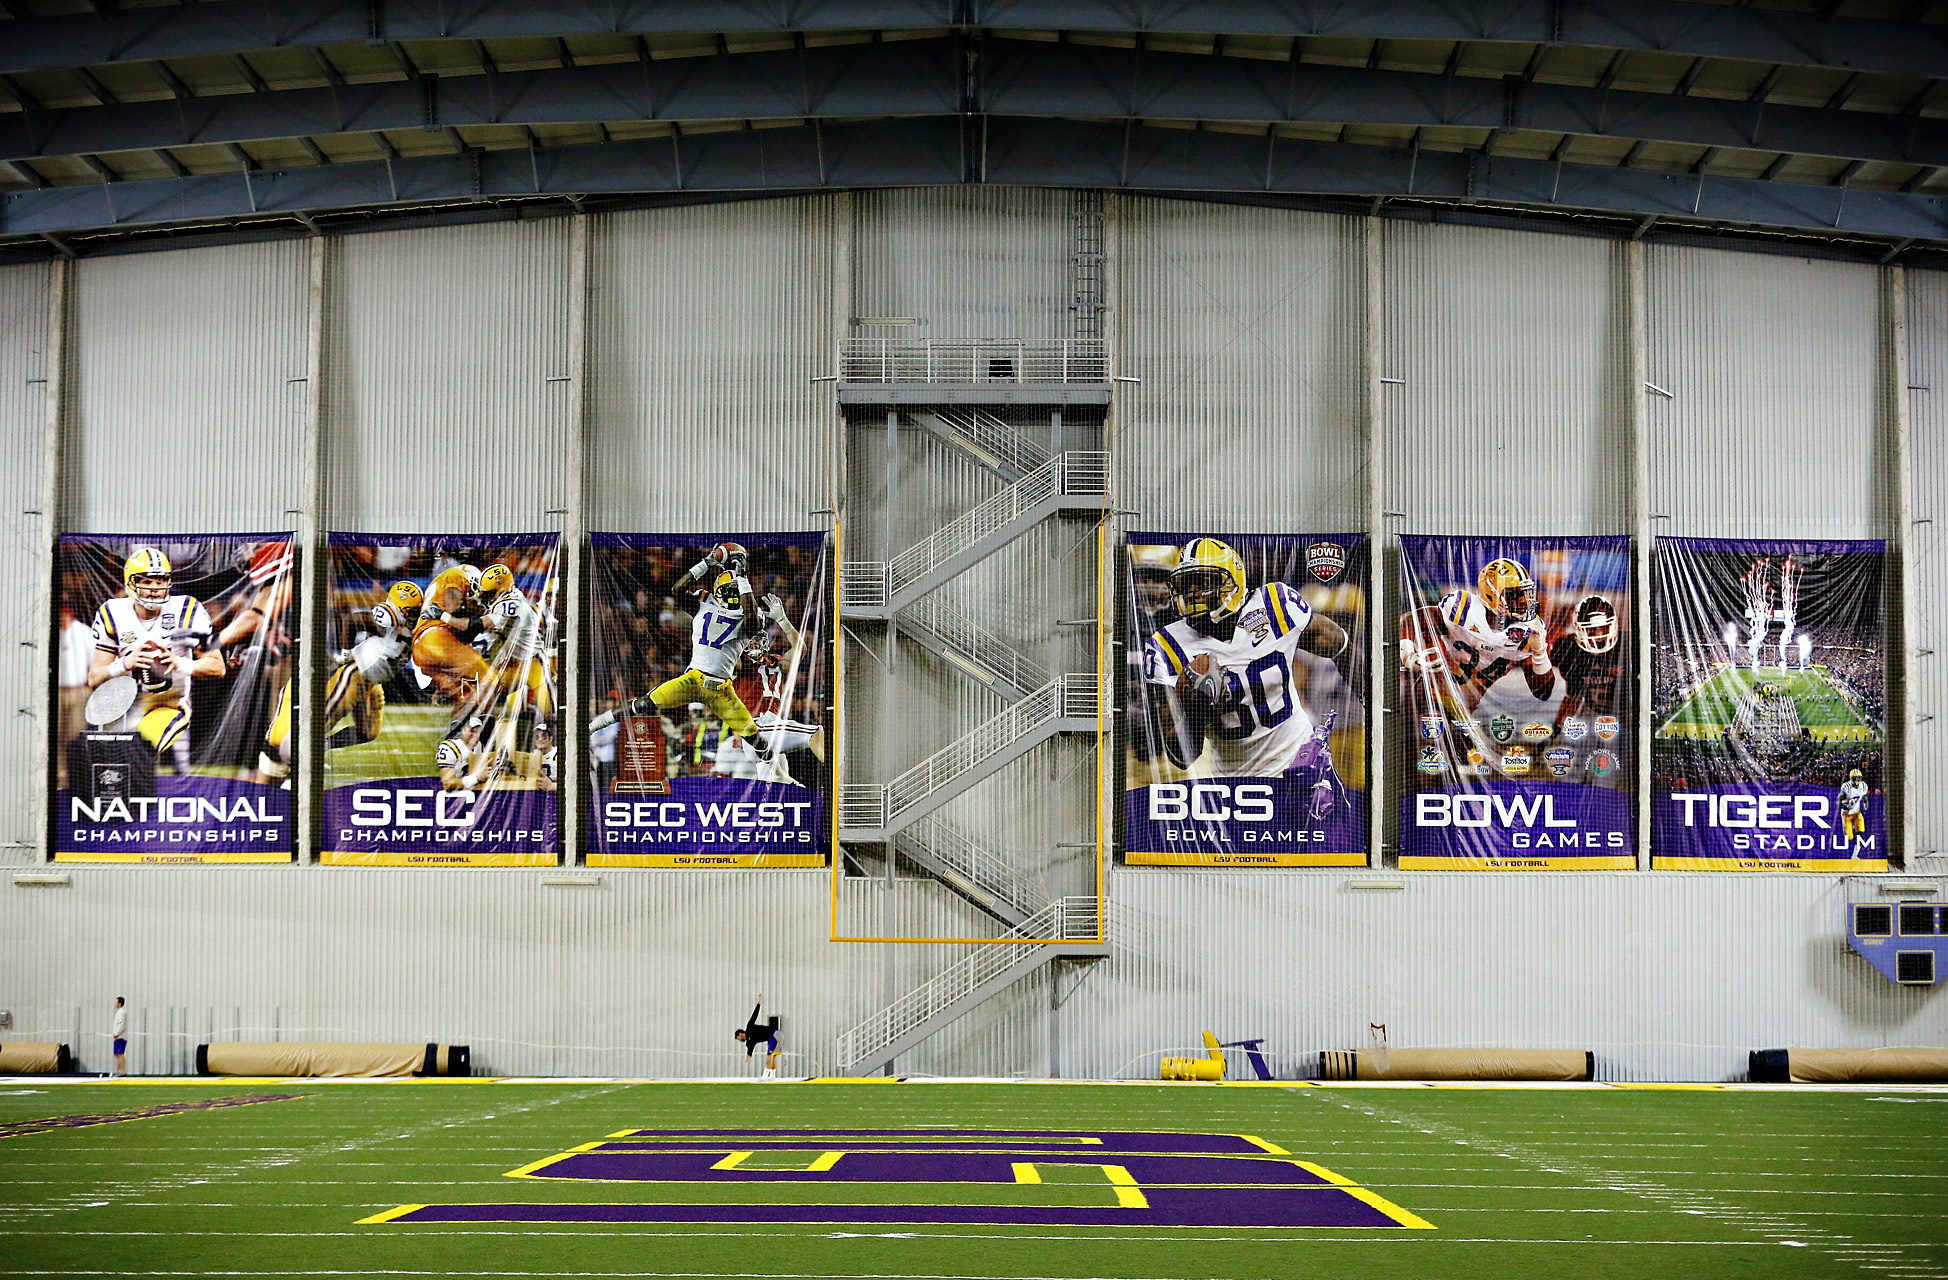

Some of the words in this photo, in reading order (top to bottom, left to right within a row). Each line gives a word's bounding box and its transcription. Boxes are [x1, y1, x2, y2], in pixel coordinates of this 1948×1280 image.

[1310, 547, 1340, 558] BOWL
[1307, 558, 1344, 567] CHAMPIONSHIP
[487, 568, 508, 580] LSU
[397, 585, 418, 598] LSU
[502, 601, 516, 616] 16
[698, 612, 738, 651] 17
[1480, 644, 1494, 652] LSU
[1595, 723, 1618, 731] COTTON
[1504, 756, 1528, 765] Tostitos
[72, 797, 283, 822] NATIONAL
[351, 789, 474, 827] SEC
[1149, 784, 1273, 822] BCS
[605, 803, 685, 826] SEC
[695, 803, 810, 826] WEST
[1417, 794, 1576, 827] BOWL
[1672, 794, 1830, 828] TIGER
[74, 830, 277, 842] CHAMPIONSHIPS
[341, 830, 543, 842] CHAMPIONSHIPS
[607, 831, 810, 842] CHAMPIONSHIPS
[1167, 830, 1231, 842] BOWL
[1244, 831, 1324, 841] GAMES
[1513, 832, 1623, 847] GAMES
[1734, 834, 1875, 850] STADIUM
